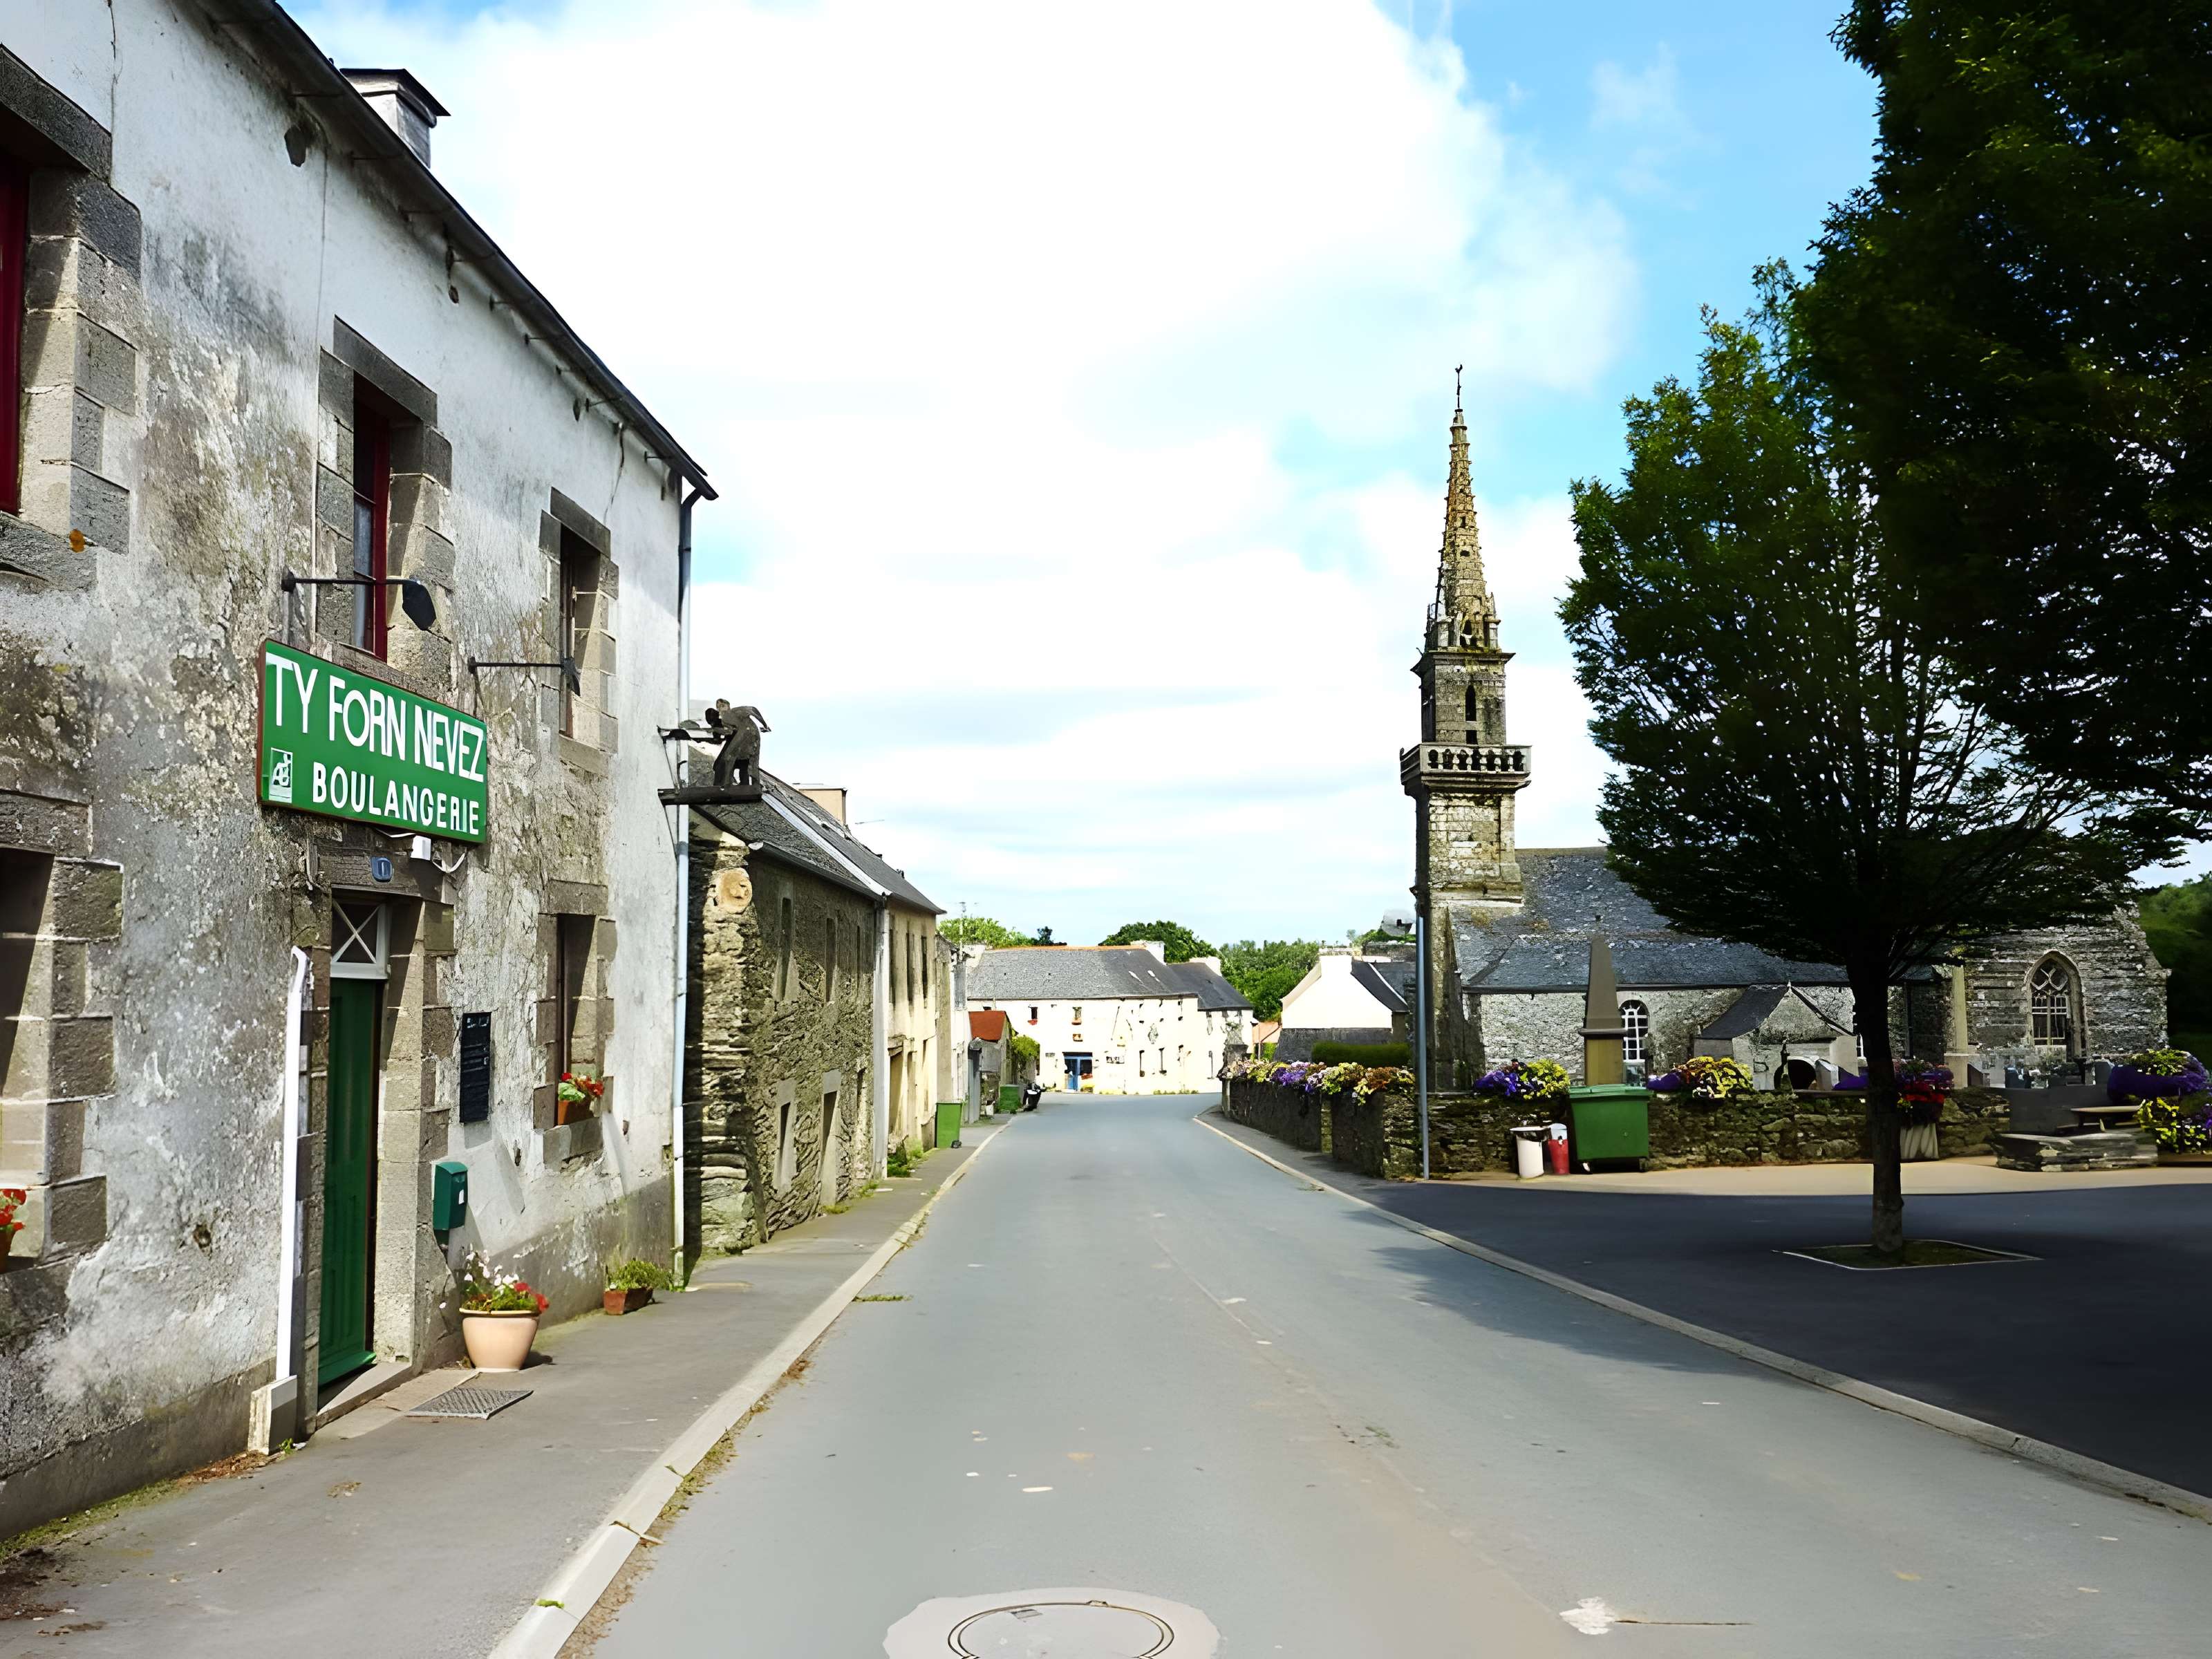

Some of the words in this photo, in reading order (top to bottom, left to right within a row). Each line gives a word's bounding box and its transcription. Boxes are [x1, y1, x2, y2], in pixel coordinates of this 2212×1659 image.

[265, 652, 318, 733] TY
[329, 675, 406, 760] FORN
[414, 704, 484, 782] NEVEZ
[312, 761, 479, 835] BOULANGERIE
